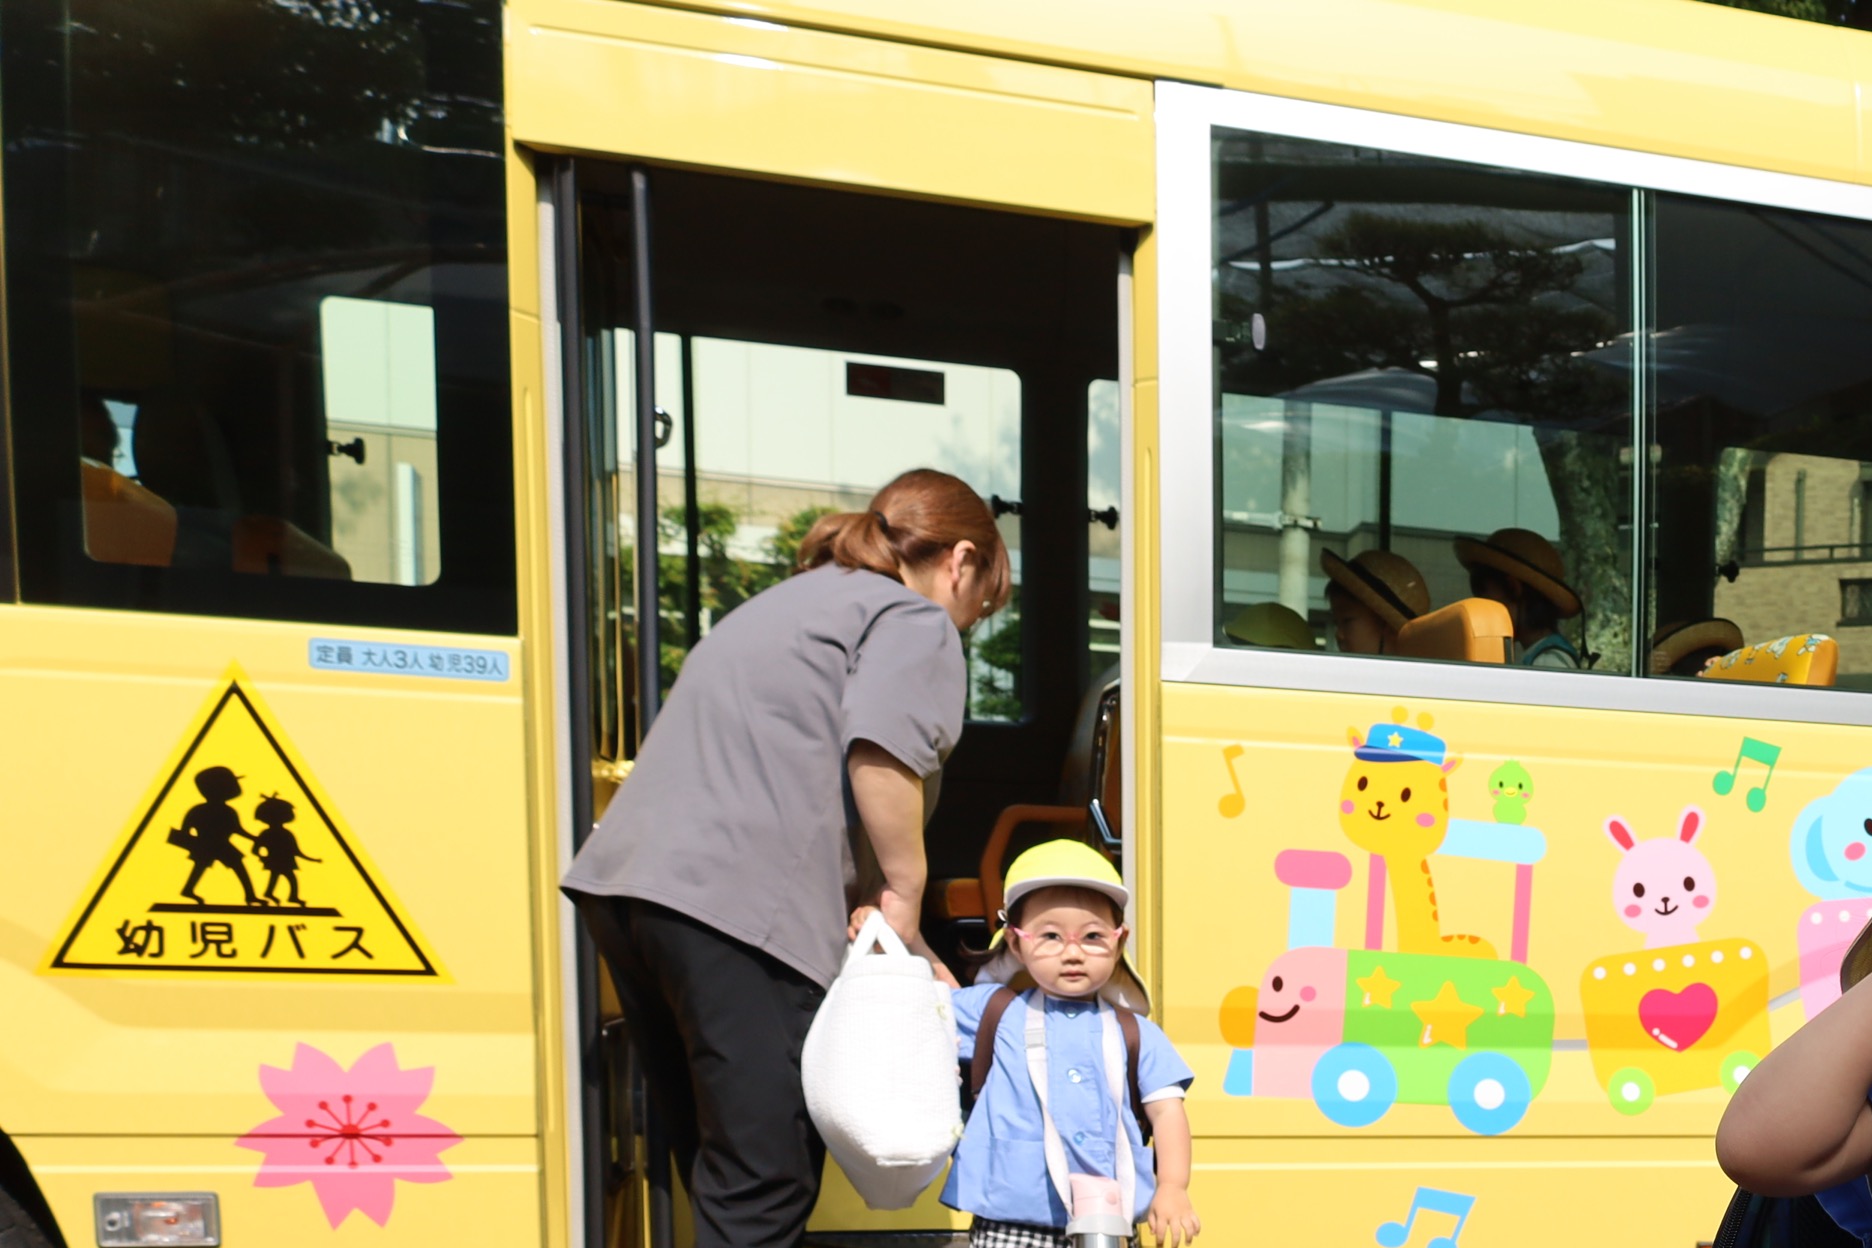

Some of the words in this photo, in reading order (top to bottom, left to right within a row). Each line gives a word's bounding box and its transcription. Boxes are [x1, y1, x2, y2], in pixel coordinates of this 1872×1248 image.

[316, 644, 353, 667] 定員
[115, 918, 375, 961] 幼児バス
